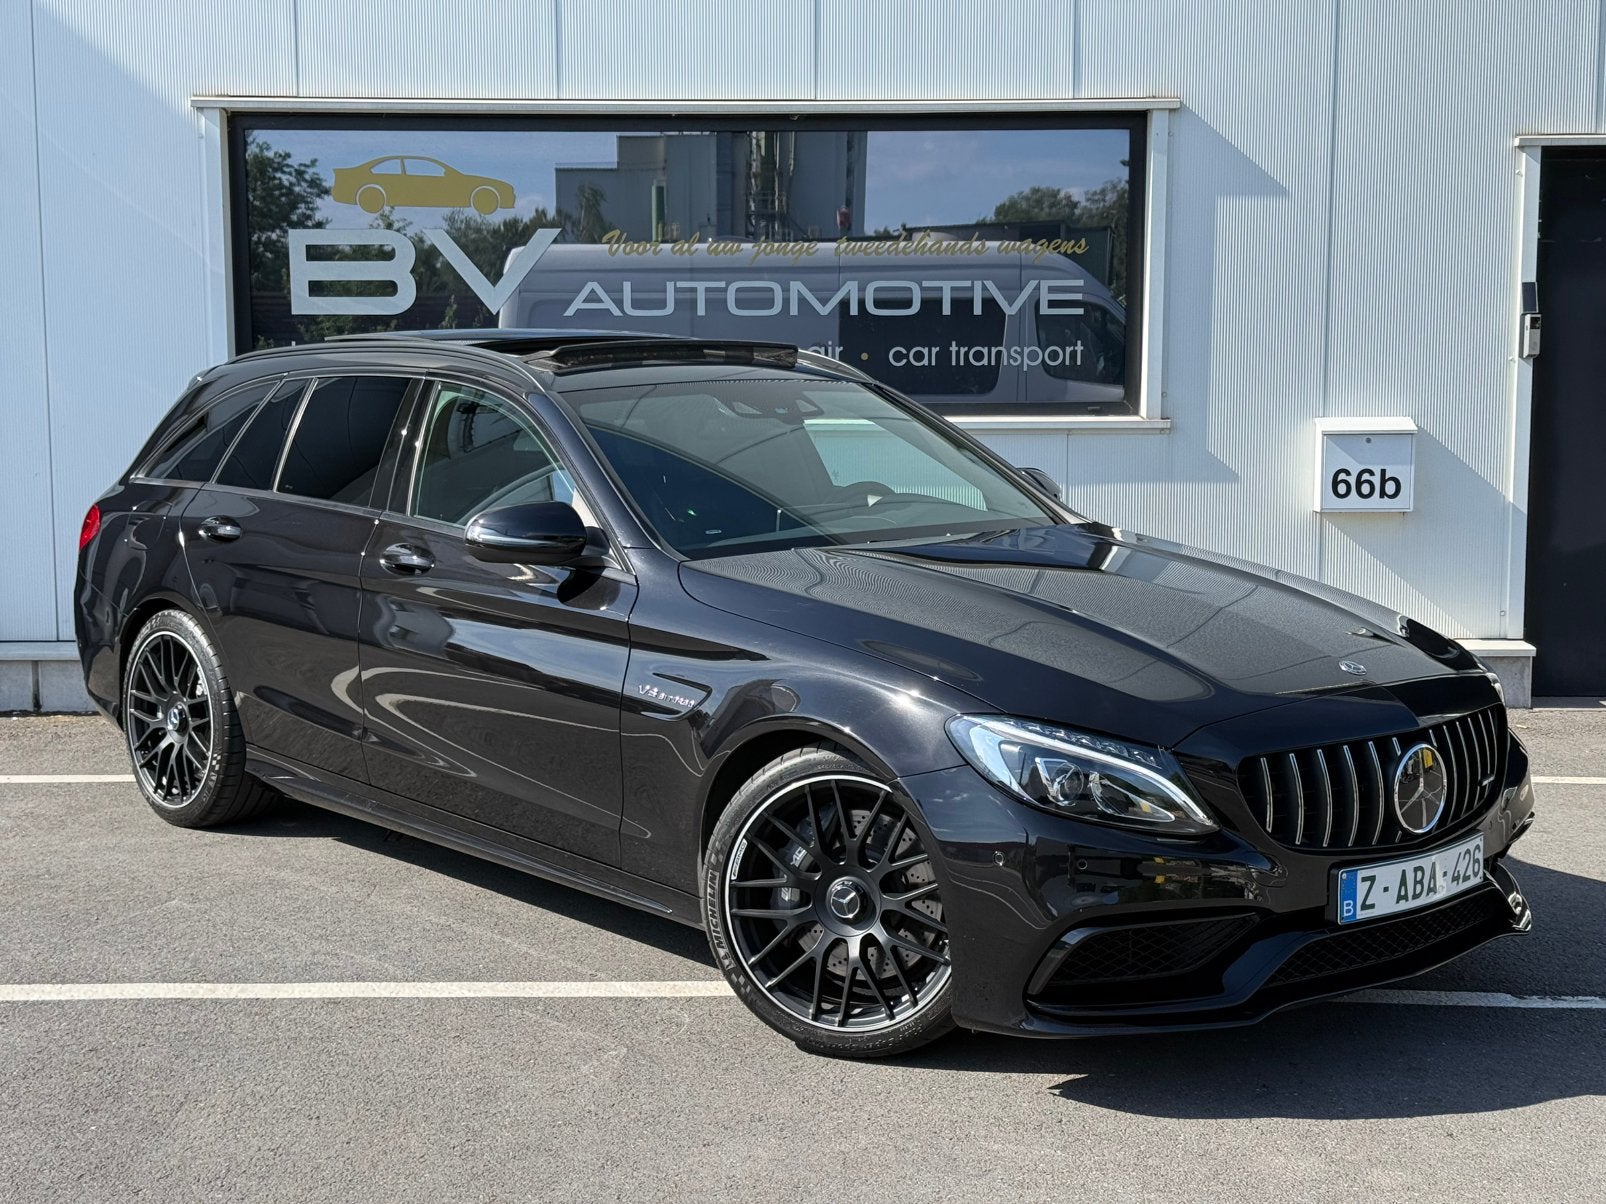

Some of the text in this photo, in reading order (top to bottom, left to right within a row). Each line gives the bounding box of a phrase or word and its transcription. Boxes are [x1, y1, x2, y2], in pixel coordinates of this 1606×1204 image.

[602, 229, 1090, 267] Voor al uw jonge tweedehands wagens
[289, 228, 563, 315] BV
[563, 279, 1085, 317] AUTOMOTIVE
[889, 345, 940, 367] car
[950, 339, 1084, 372] transport
[1331, 468, 1402, 499] 66b
[1360, 843, 1481, 912] Z-ABA-426
[707, 869, 728, 950] MICHELIN
[1343, 900, 1354, 917] B
